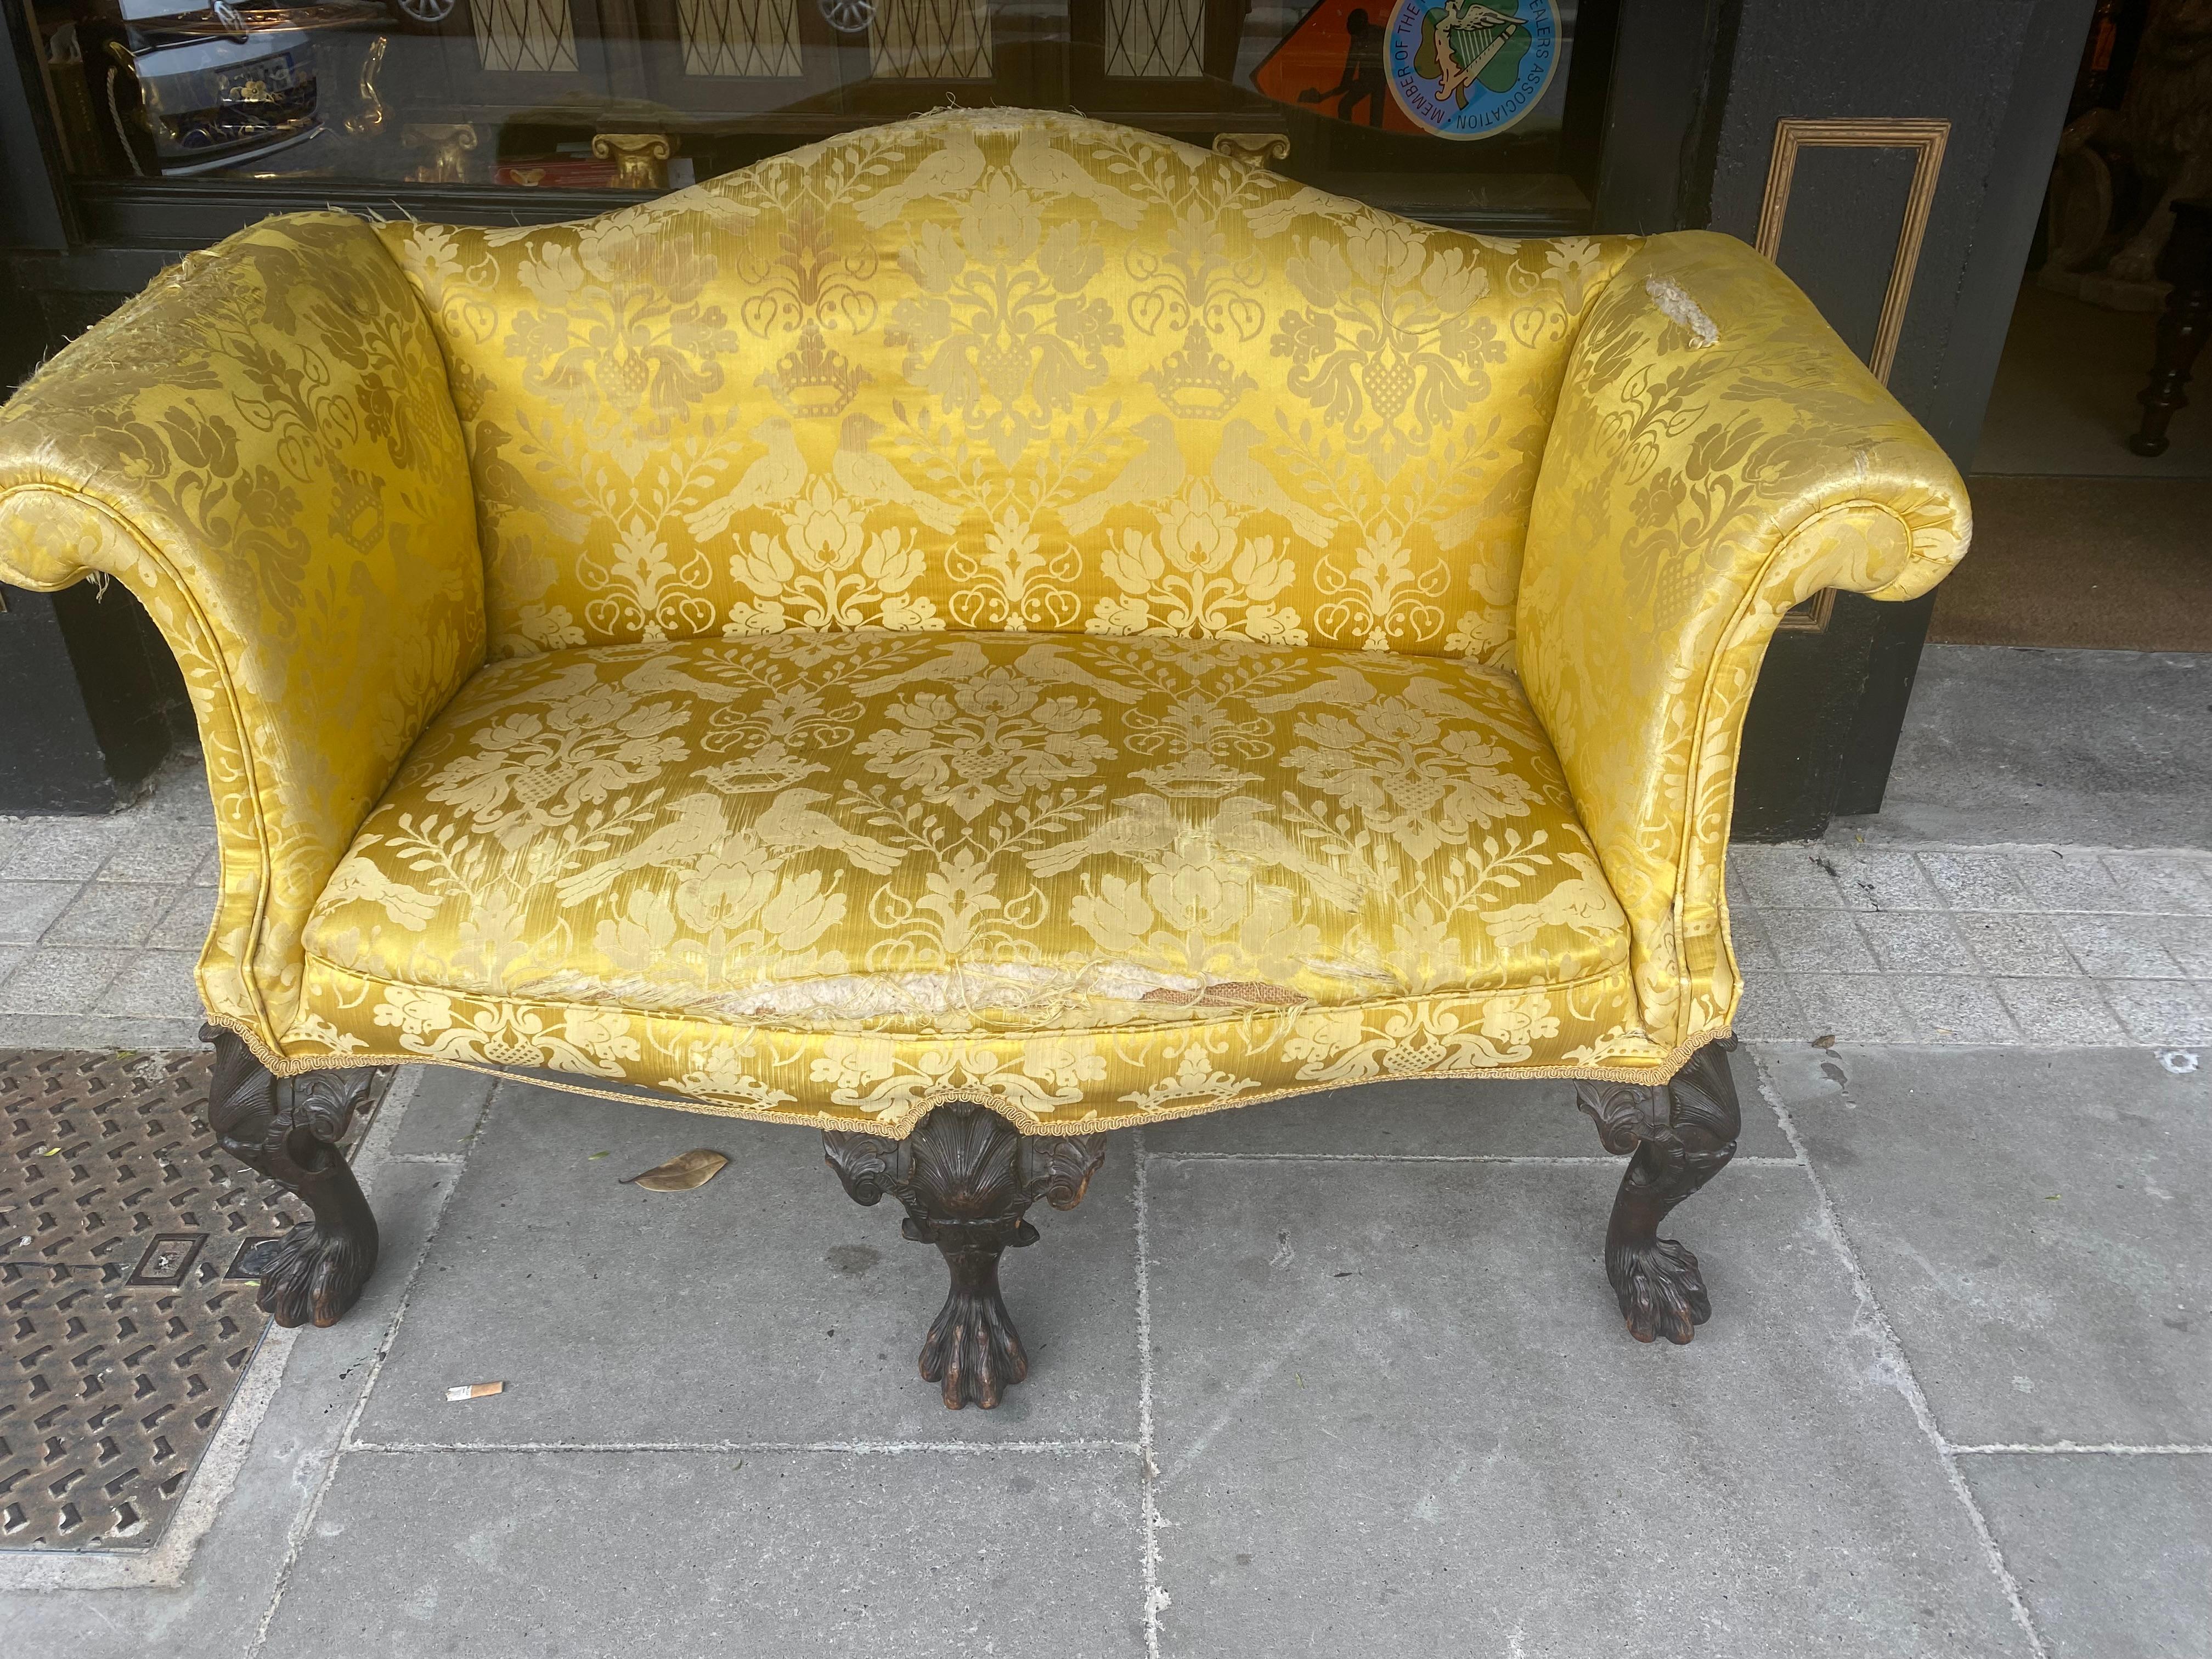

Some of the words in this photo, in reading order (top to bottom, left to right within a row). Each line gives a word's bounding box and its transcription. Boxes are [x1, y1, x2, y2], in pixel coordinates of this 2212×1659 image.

[1397, 3, 1420, 33] THE
[1530, 0, 1550, 58] EALERS
[1395, 40, 1408, 60] OF
[1398, 66, 1445, 123] MEMBER
[1457, 63, 1544, 129] ASSOCIATION
